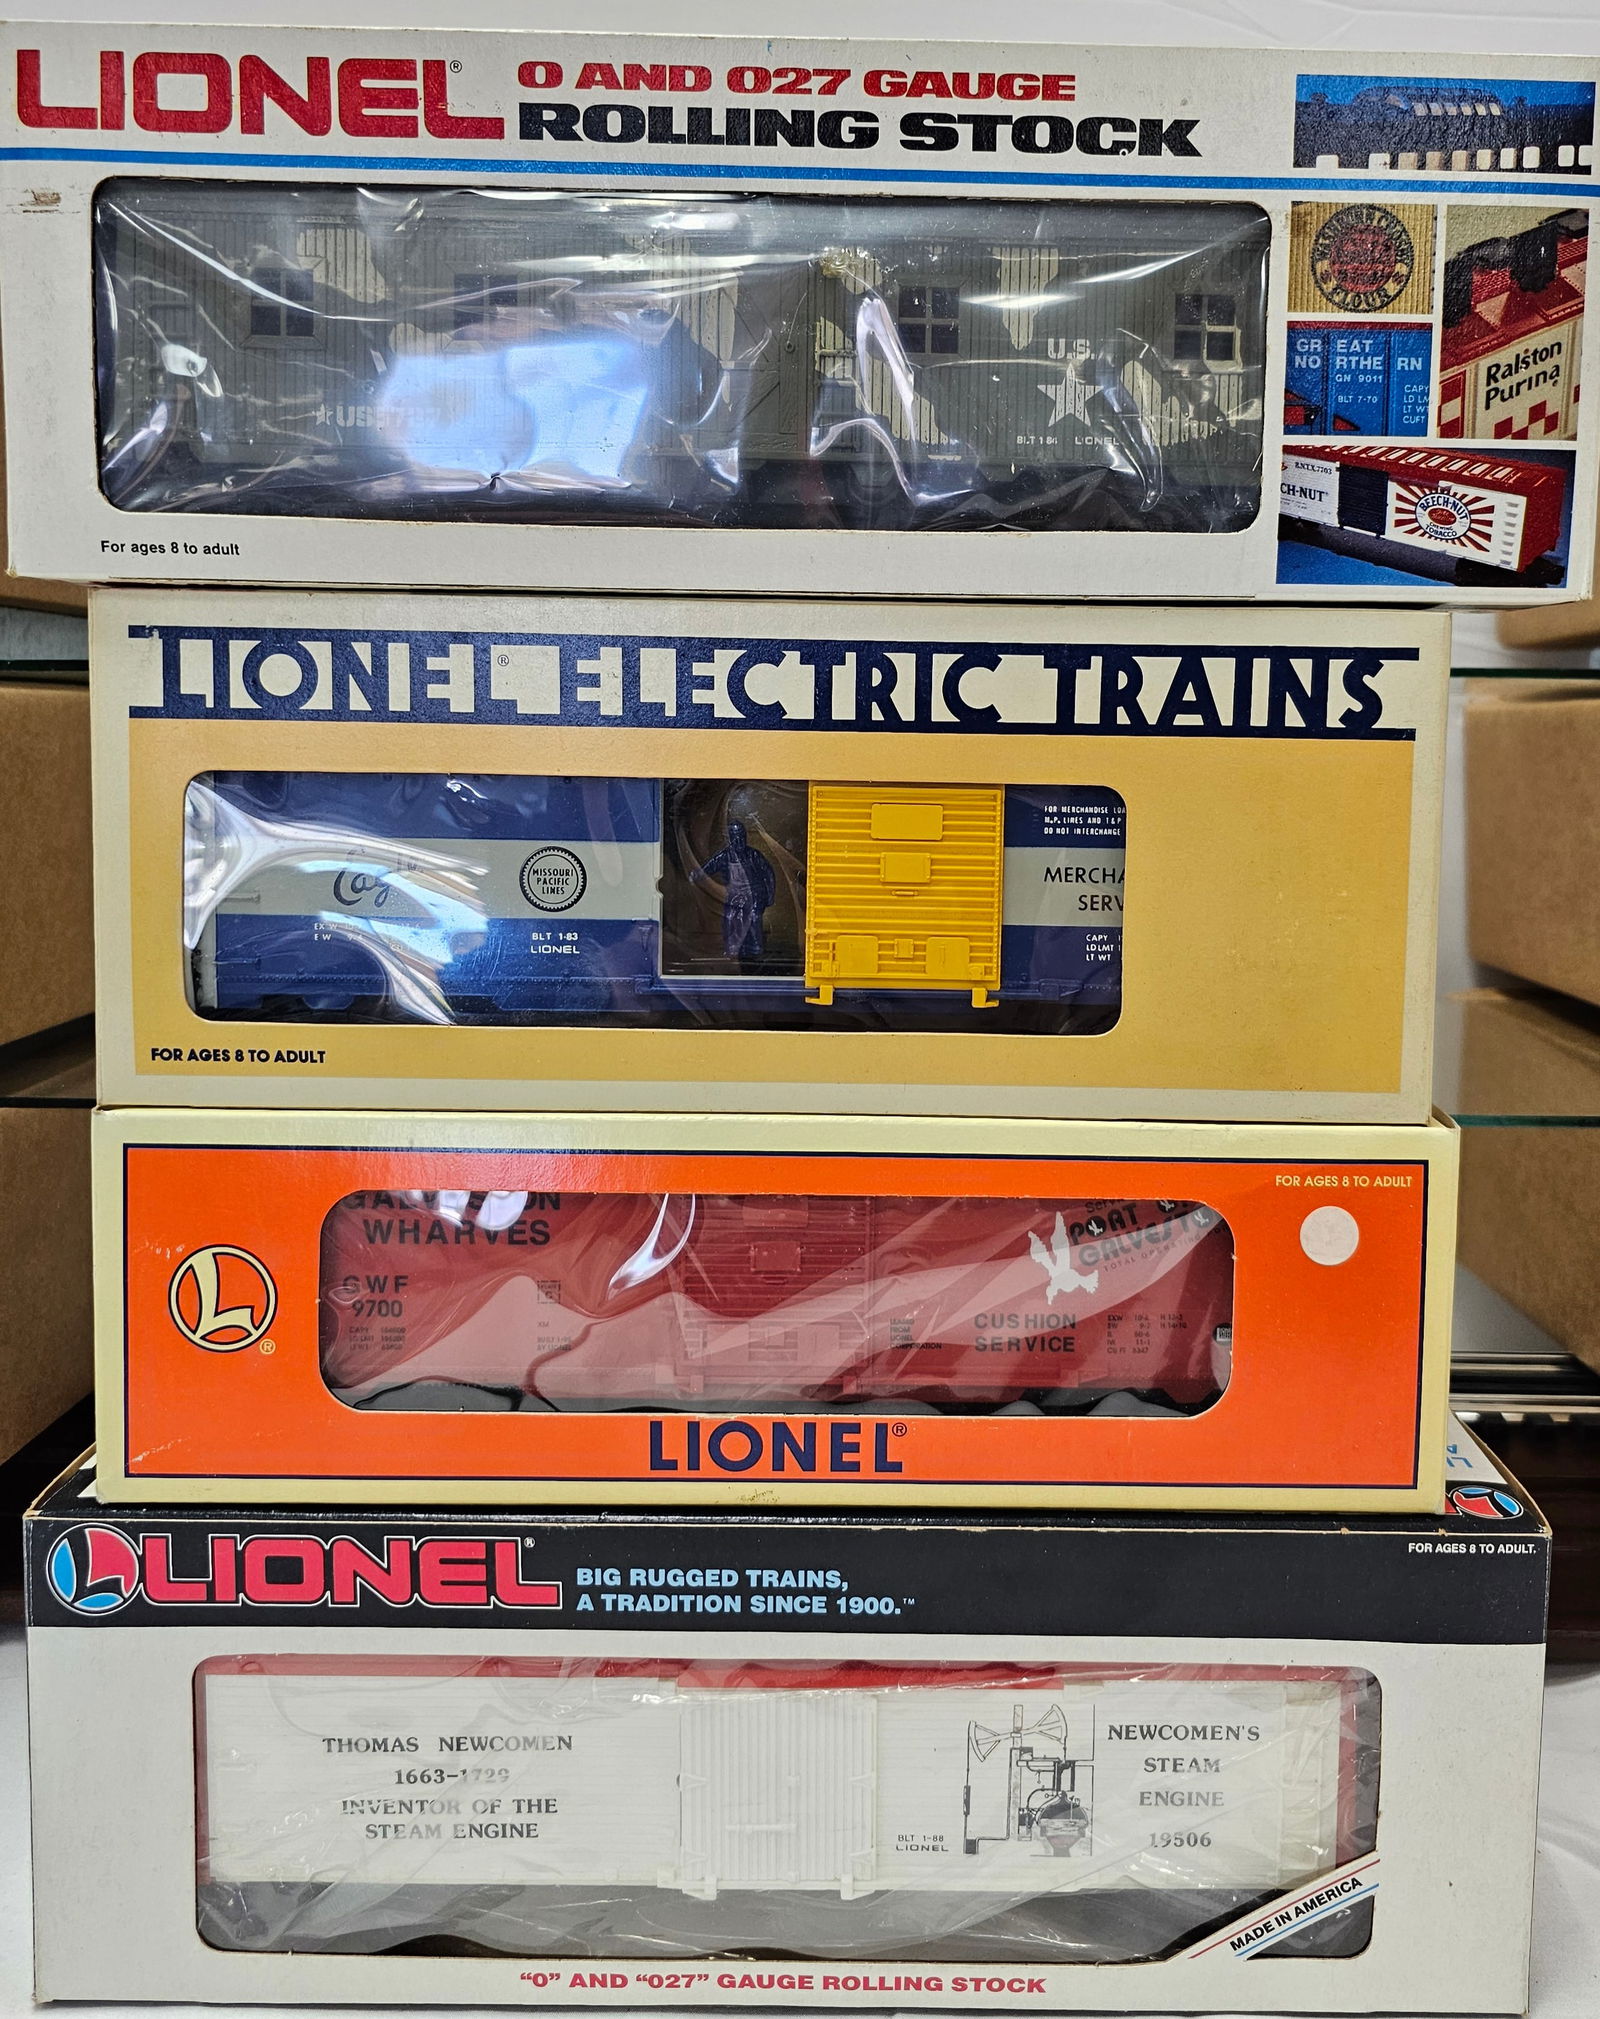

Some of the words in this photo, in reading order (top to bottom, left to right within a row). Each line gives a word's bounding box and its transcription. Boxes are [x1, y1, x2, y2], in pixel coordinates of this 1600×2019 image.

[575, 62, 711, 92] AND
[863, 69, 1076, 101] GAUGE
[519, 102, 880, 149] ROLLING
[900, 112, 1202, 157] STOCK
[1047, 338, 1096, 360] U.S.
[1486, 341, 1562, 387] Ralston
[1358, 375, 1383, 383] 9011
[1485, 364, 1560, 411] Purina
[1357, 396, 1378, 404] 7-70
[1075, 437, 1119, 446] LIONEL
[1419, 496, 1469, 521] BEECH-NUT
[1425, 524, 1458, 538] TOBACCO
[101, 540, 126, 553] For
[131, 543, 166, 556] ages
[171, 542, 180, 554] 8
[184, 542, 198, 554] to
[203, 543, 240, 556] adult
[558, 634, 1003, 734] ELECTRIC
[1043, 644, 1385, 740] TRAINS
[1044, 805, 1057, 813] FOR
[1061, 806, 1108, 814] MERCHANDISE
[1063, 816, 1083, 824] LINES
[1056, 827, 1069, 835] NOT
[532, 868, 574, 877] MISSOURI
[536, 877, 569, 886] PACIFIC
[542, 886, 565, 895] LINES
[532, 932, 552, 941] BLT
[1085, 933, 1108, 942] CAPY
[530, 945, 580, 954] LIONEL
[151, 1048, 183, 1061] FOR
[187, 1048, 231, 1062] AGES
[235, 1049, 245, 1062] 8
[248, 1049, 270, 1063] TO
[274, 1050, 326, 1063] ADULT
[1275, 1175, 1300, 1187] FOR
[1304, 1175, 1338, 1187] AGES
[1342, 1175, 1350, 1187] 8
[1353, 1175, 1370, 1187] TO
[1373, 1175, 1413, 1188] ADULT
[362, 1219, 551, 1245] WHARVES
[352, 1299, 403, 1318] 9700
[974, 1313, 1077, 1329] CUSHION
[974, 1336, 1076, 1352] SERVICE
[1408, 1542, 1432, 1553] FOR
[1435, 1543, 1466, 1554] AGES
[1469, 1544, 1476, 1554] 8
[1479, 1544, 1495, 1554] TO
[576, 1568, 621, 1586] BIG
[630, 1568, 739, 1587] RUGGED
[745, 1569, 849, 1592] TRAINS,
[576, 1594, 594, 1611] A
[600, 1594, 742, 1613] TRADITION
[750, 1595, 827, 1614] SINCE
[1107, 1724, 1260, 1742] NEWCOMEN'S
[322, 1737, 419, 1753] THOMAS
[439, 1735, 573, 1752] NEWCOMEN
[1143, 1757, 1221, 1773] STEAM
[341, 1799, 462, 1815] INVENTOR
[472, 1799, 502, 1815] OF
[512, 1798, 558, 1814] THE
[1139, 1791, 1225, 1807] ENGINE
[365, 1823, 442, 1840] STEAM
[453, 1823, 539, 1839] ENGINE
[898, 1834, 914, 1842] BLT
[923, 1834, 944, 1842] 1-88
[1150, 1831, 1212, 1848] 19506
[896, 1844, 949, 1852] LIONEL
[1229, 1920, 1275, 1952] MADE
[1274, 1911, 1293, 1928] IN
[1294, 1876, 1364, 1919] AMERICA
[569, 1973, 629, 1989] AND
[717, 1974, 814, 1990] GAUGE
[822, 1975, 943, 1991] ROLLING
[951, 1977, 1047, 1993] STOCK
